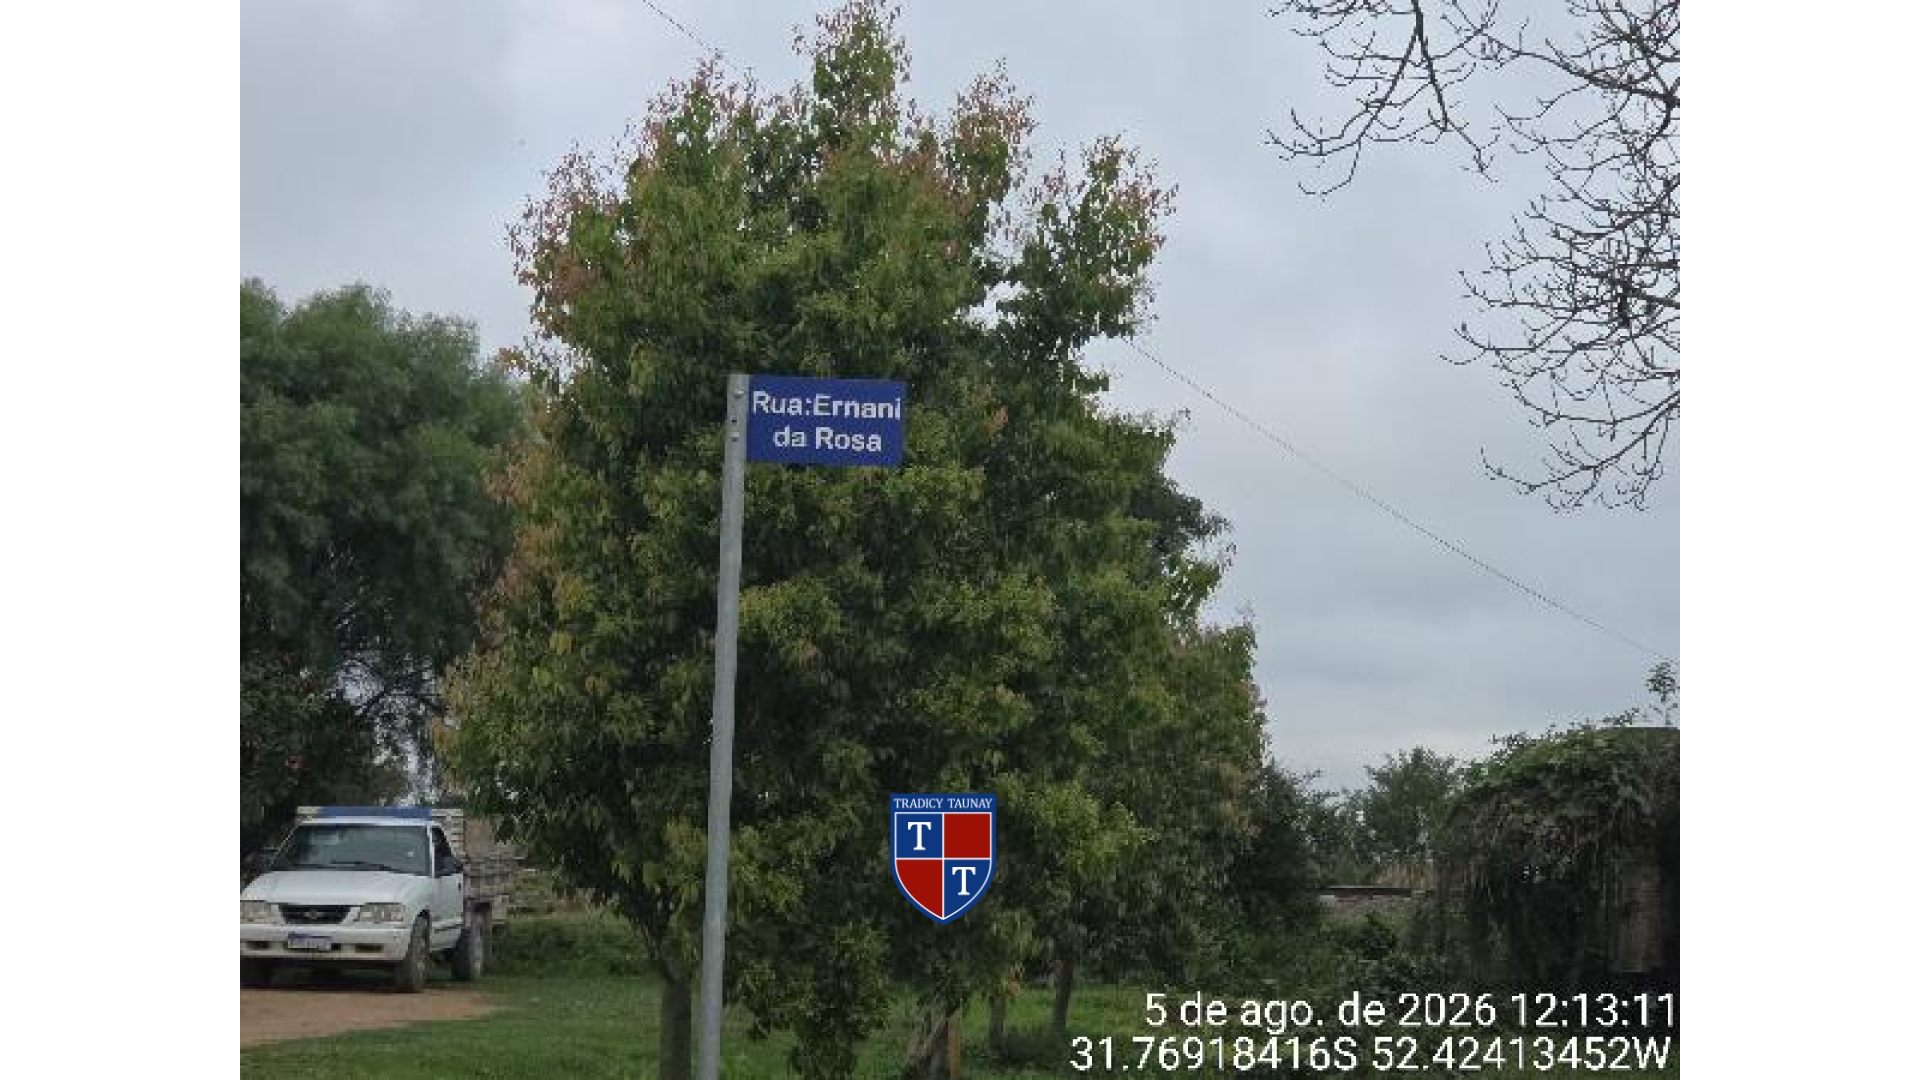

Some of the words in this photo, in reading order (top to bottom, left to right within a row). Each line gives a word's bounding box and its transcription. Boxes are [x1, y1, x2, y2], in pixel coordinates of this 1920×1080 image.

[753, 390, 901, 421] Rua:Ernani
[773, 425, 807, 448] da
[815, 426, 882, 452] Rosa
